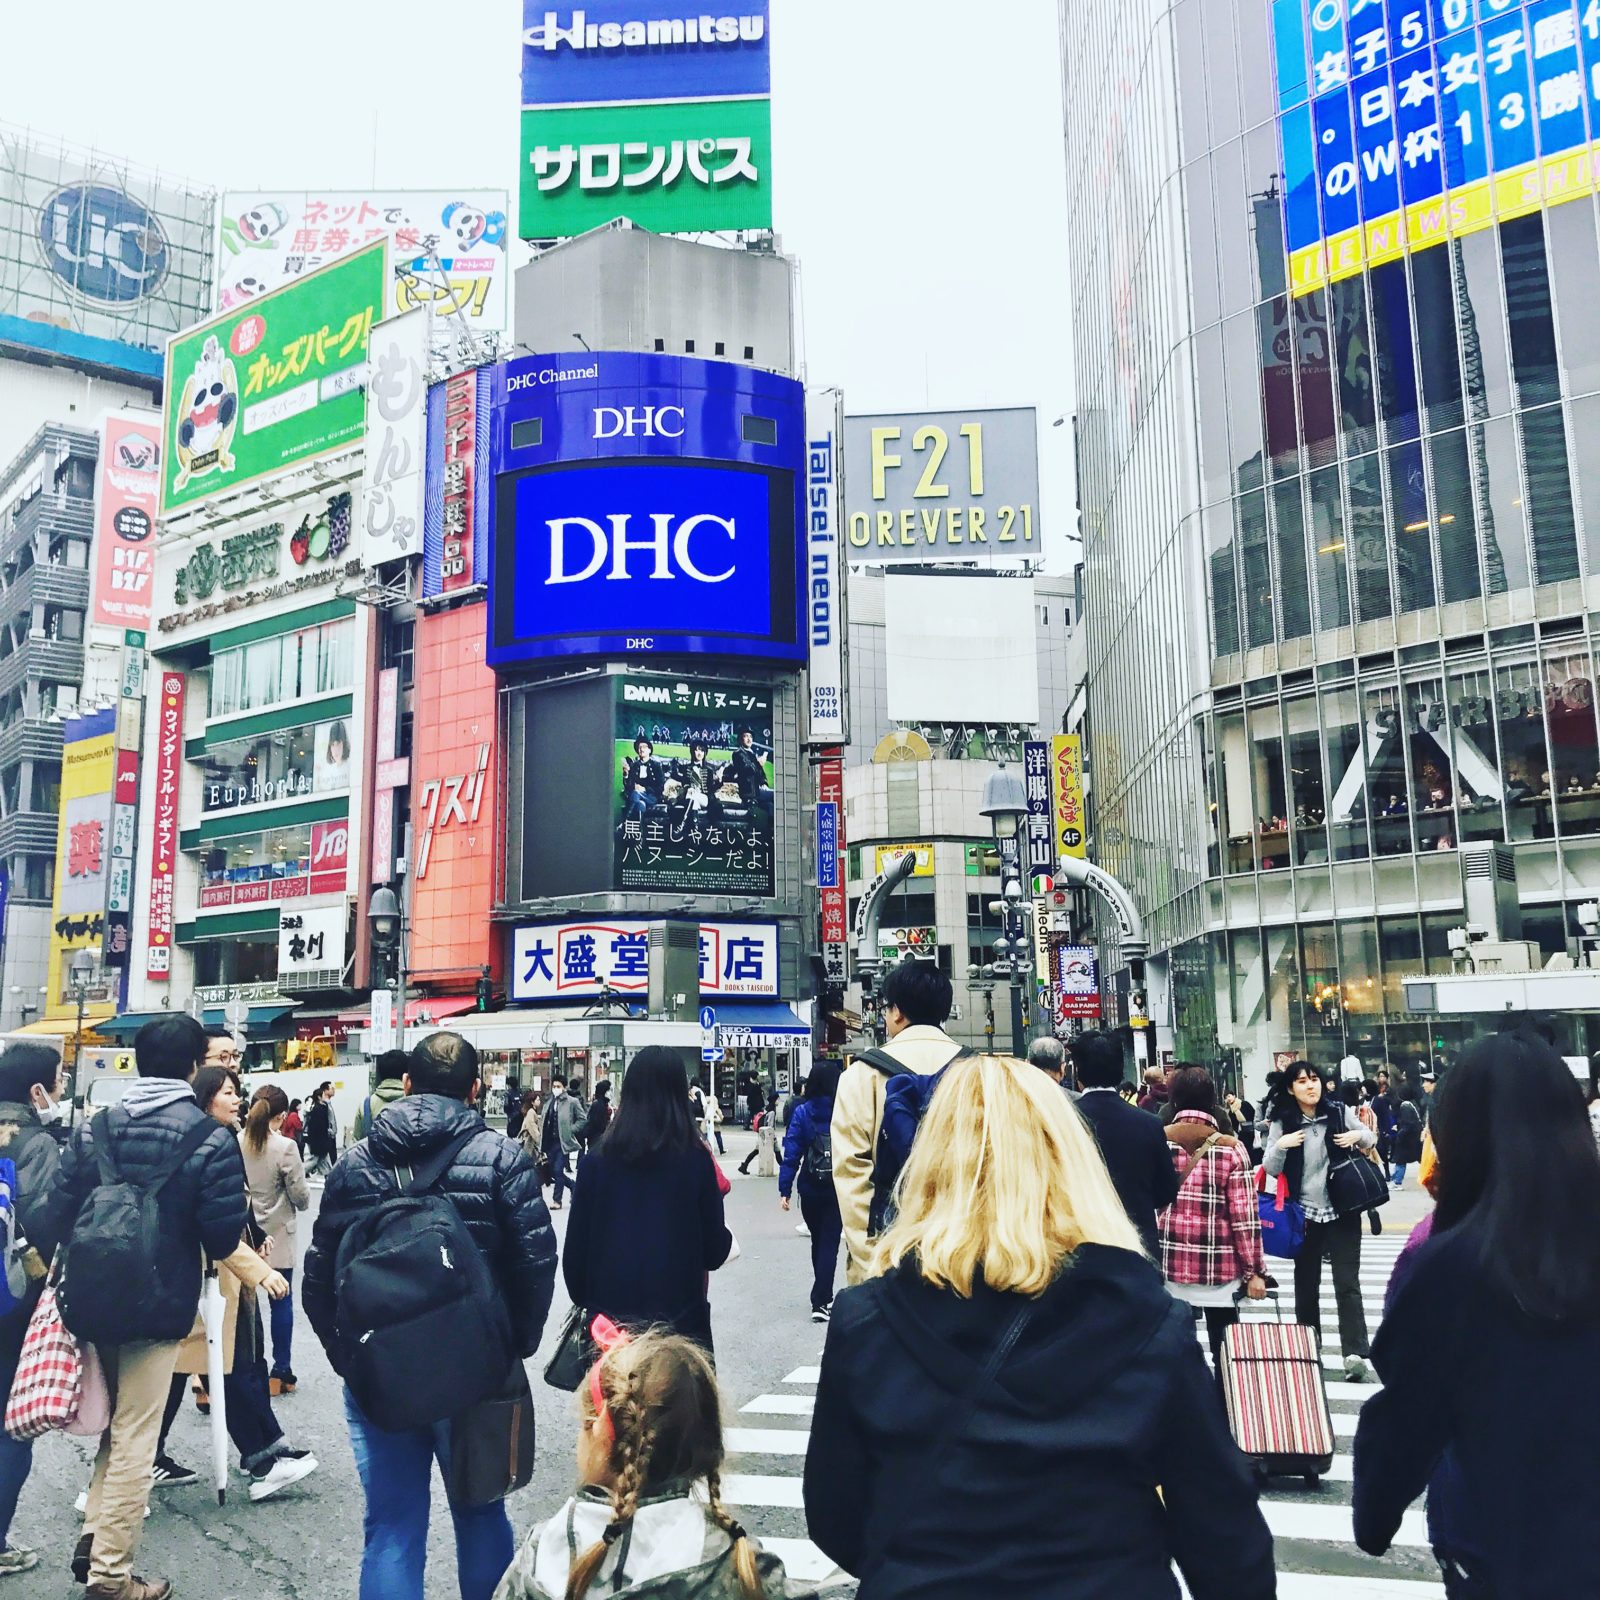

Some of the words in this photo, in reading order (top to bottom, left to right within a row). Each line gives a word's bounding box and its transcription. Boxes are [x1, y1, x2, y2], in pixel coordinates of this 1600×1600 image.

[523, 11, 764, 50] Hisamitsu
[529, 137, 758, 191] サロンパス
[244, 306, 373, 397] オッズパーク!
[334, 371, 357, 391] 検索
[507, 372, 537, 391] DHC
[539, 364, 598, 386] Channel
[592, 406, 685, 438] DHC
[367, 341, 420, 551] もんじゃ
[871, 422, 984, 500] F21
[440, 378, 469, 578] 三千里薬品
[808, 431, 834, 543] Taisei
[997, 504, 1032, 541] 21
[113, 547, 149, 570] B1F
[545, 514, 736, 585] DHC
[111, 569, 150, 592] B2F
[811, 554, 830, 647] neon
[626, 638, 654, 649] DHC
[624, 684, 671, 704] DMM
[693, 691, 767, 711] バヌーシー
[813, 698, 838, 708] 3719
[815, 686, 837, 698] (03)
[813, 708, 838, 718] 2468
[118, 771, 136, 782] JTB
[159, 709, 178, 859] ウィンターフルーツギフト
[209, 775, 305, 807] Euphoria
[416, 742, 490, 879] クスリ
[1026, 748, 1050, 865] 洋服の青山
[69, 819, 103, 877] 薬
[314, 828, 347, 864] JTB
[622, 819, 769, 847] 馬主じゃないよ、
[821, 808, 833, 883] 大盛堂商事ビル
[1062, 832, 1079, 844] 4F
[622, 844, 769, 870] バヌーシーだよ!
[725, 984, 744, 992] BOOKS
[747, 984, 773, 992] TAISEIDO
